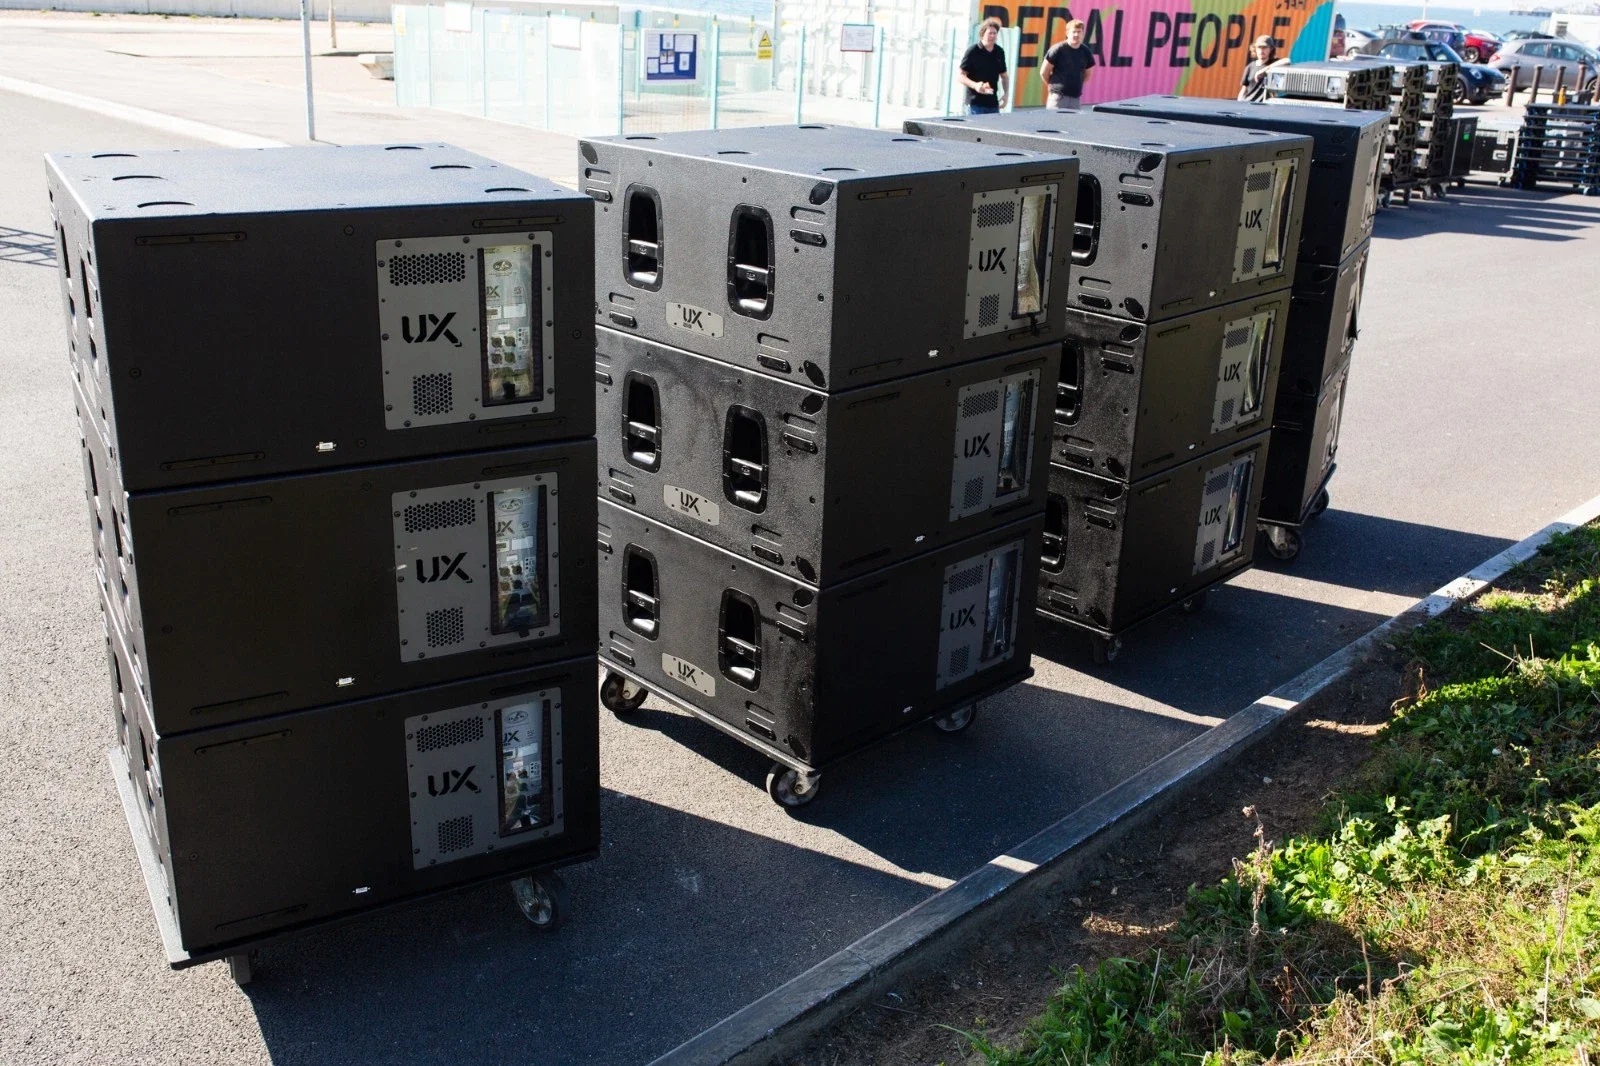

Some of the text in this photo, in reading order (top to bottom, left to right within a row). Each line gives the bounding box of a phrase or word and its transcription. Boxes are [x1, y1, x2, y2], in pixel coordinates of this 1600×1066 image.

[1244, 208, 1263, 231] UX
[979, 247, 1007, 274] UX
[402, 312, 463, 348] UX
[683, 307, 704, 331] UX
[1223, 361, 1241, 382] UX
[964, 432, 991, 458] UX
[681, 491, 700, 516] UX
[1204, 504, 1222, 526] UX
[416, 552, 473, 584] UX
[950, 604, 976, 630] UX
[678, 661, 697, 686] UX
[428, 765, 482, 797] UX
